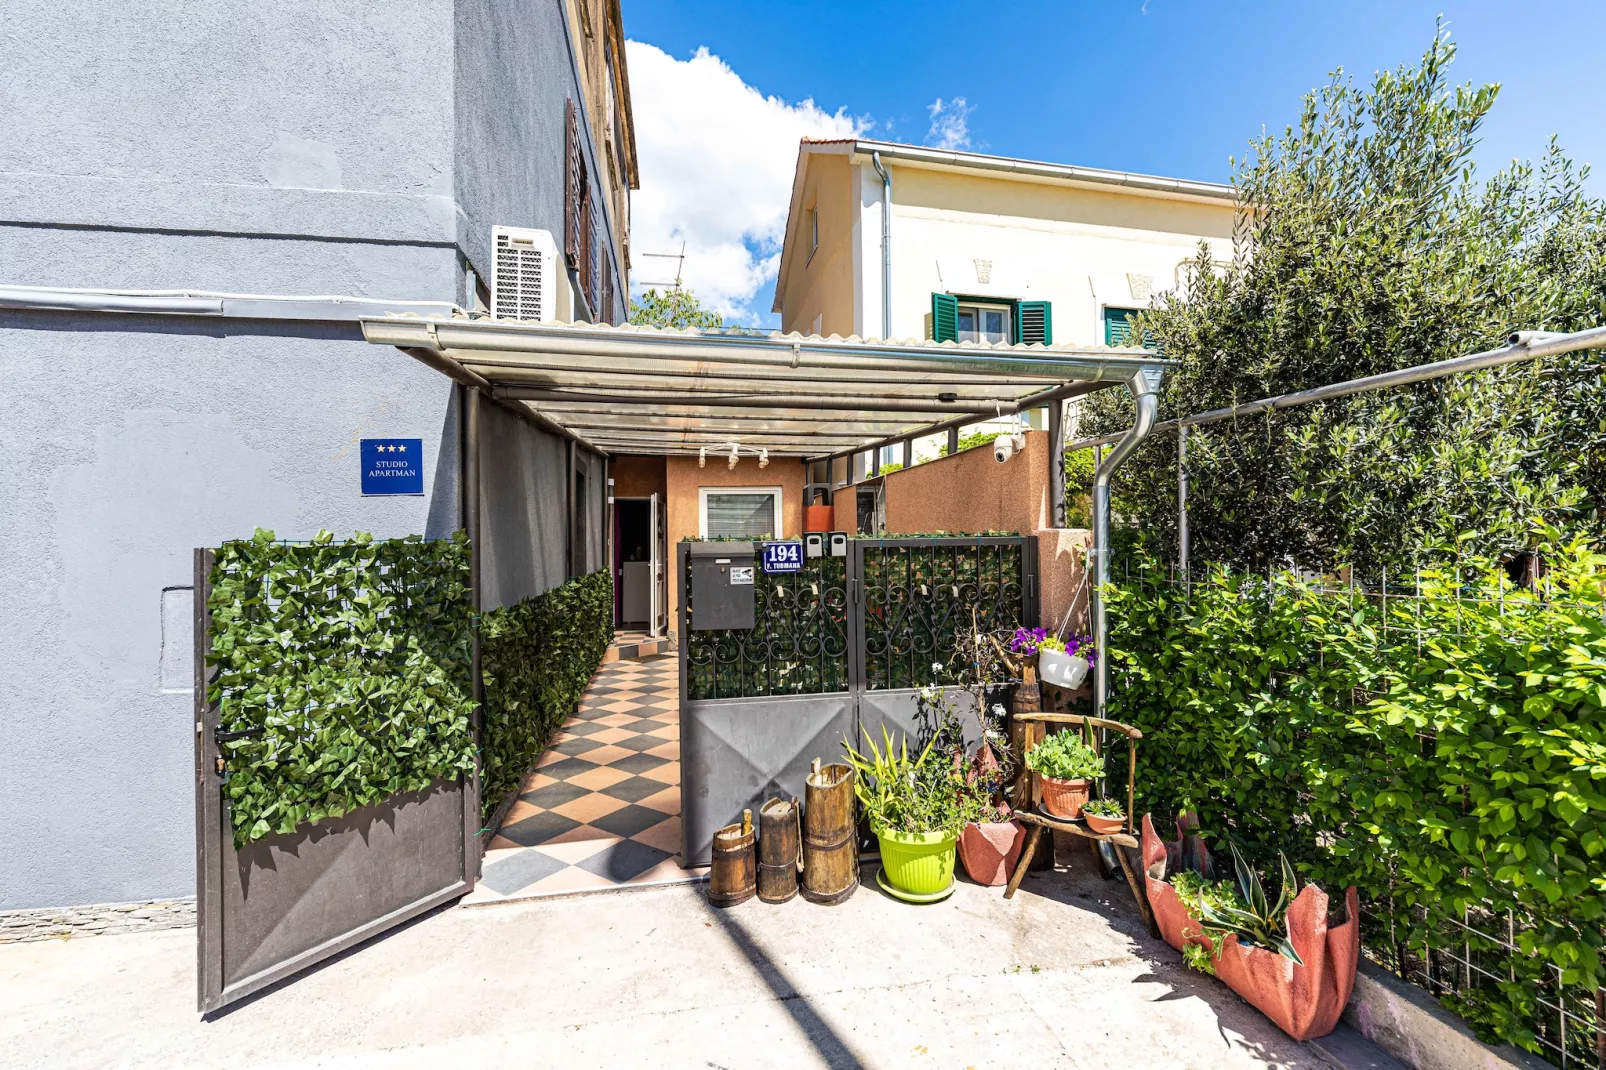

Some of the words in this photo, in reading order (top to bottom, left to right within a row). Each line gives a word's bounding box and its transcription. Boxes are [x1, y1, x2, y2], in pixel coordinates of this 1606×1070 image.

[376, 460, 408, 468] STUDIO
[369, 469, 416, 477] APARTMAN
[769, 545, 798, 561] 194
